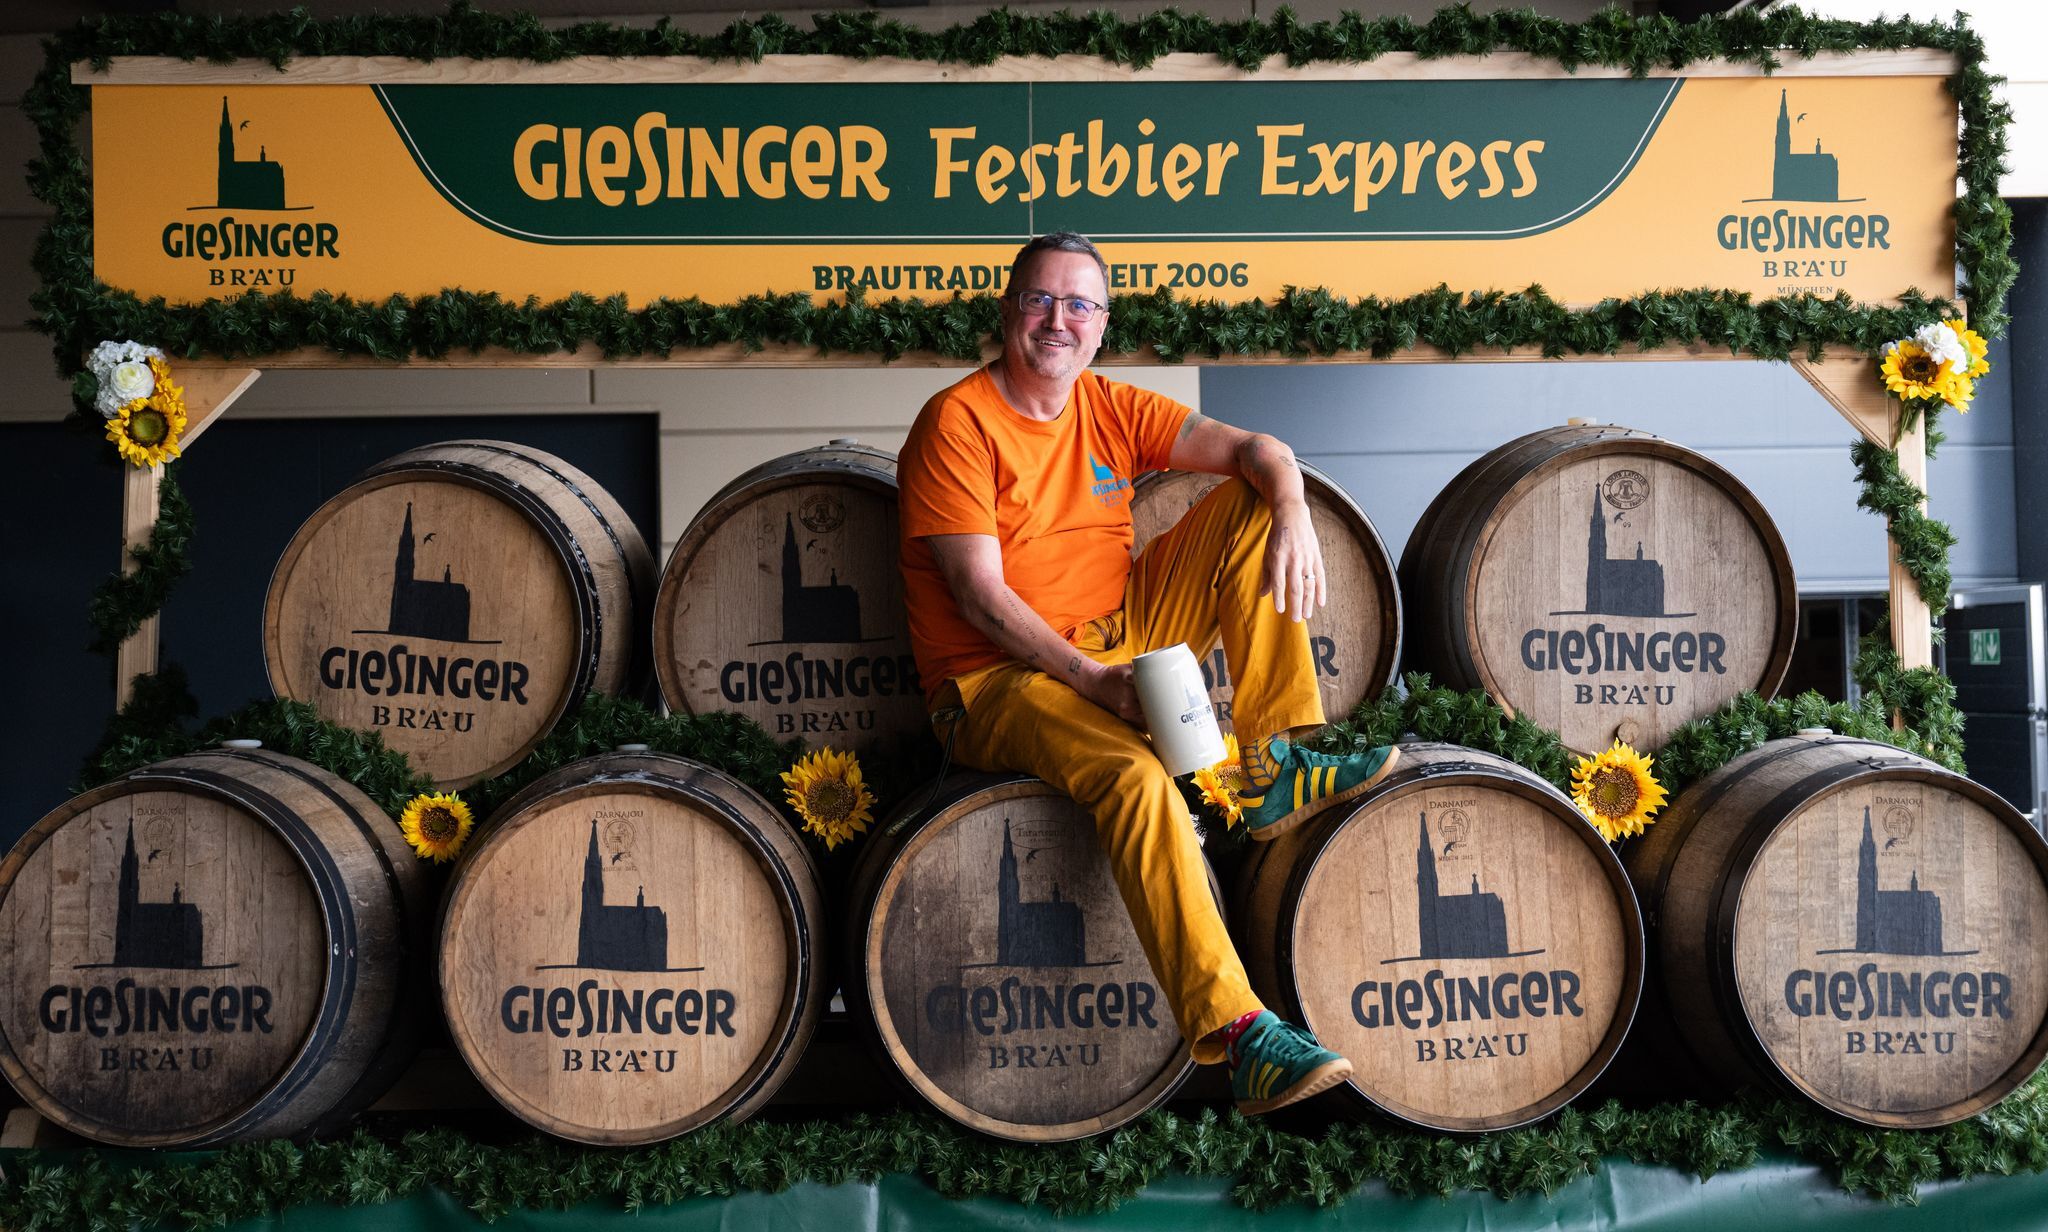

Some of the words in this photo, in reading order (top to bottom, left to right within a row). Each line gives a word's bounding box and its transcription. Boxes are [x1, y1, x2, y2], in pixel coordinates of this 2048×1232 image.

[929, 118, 1239, 204] Festbier
[1255, 123, 1545, 212] Express
[209, 268, 296, 286] BRÄU
[1106, 263, 1158, 288] EIT
[1167, 262, 1249, 288] 2006
[1763, 260, 1848, 278] BRÄU
[1574, 684, 1677, 706] BRÄU
[372, 705, 476, 732] BRÄU
[776, 709, 877, 734] BRÄU
[1415, 1033, 1528, 1062] BRÄU
[1846, 1031, 1957, 1054] BRÄU
[100, 1047, 214, 1072] BRÄU
[562, 1048, 678, 1073] BRÄU
[989, 1043, 1102, 1069] BRÄU
